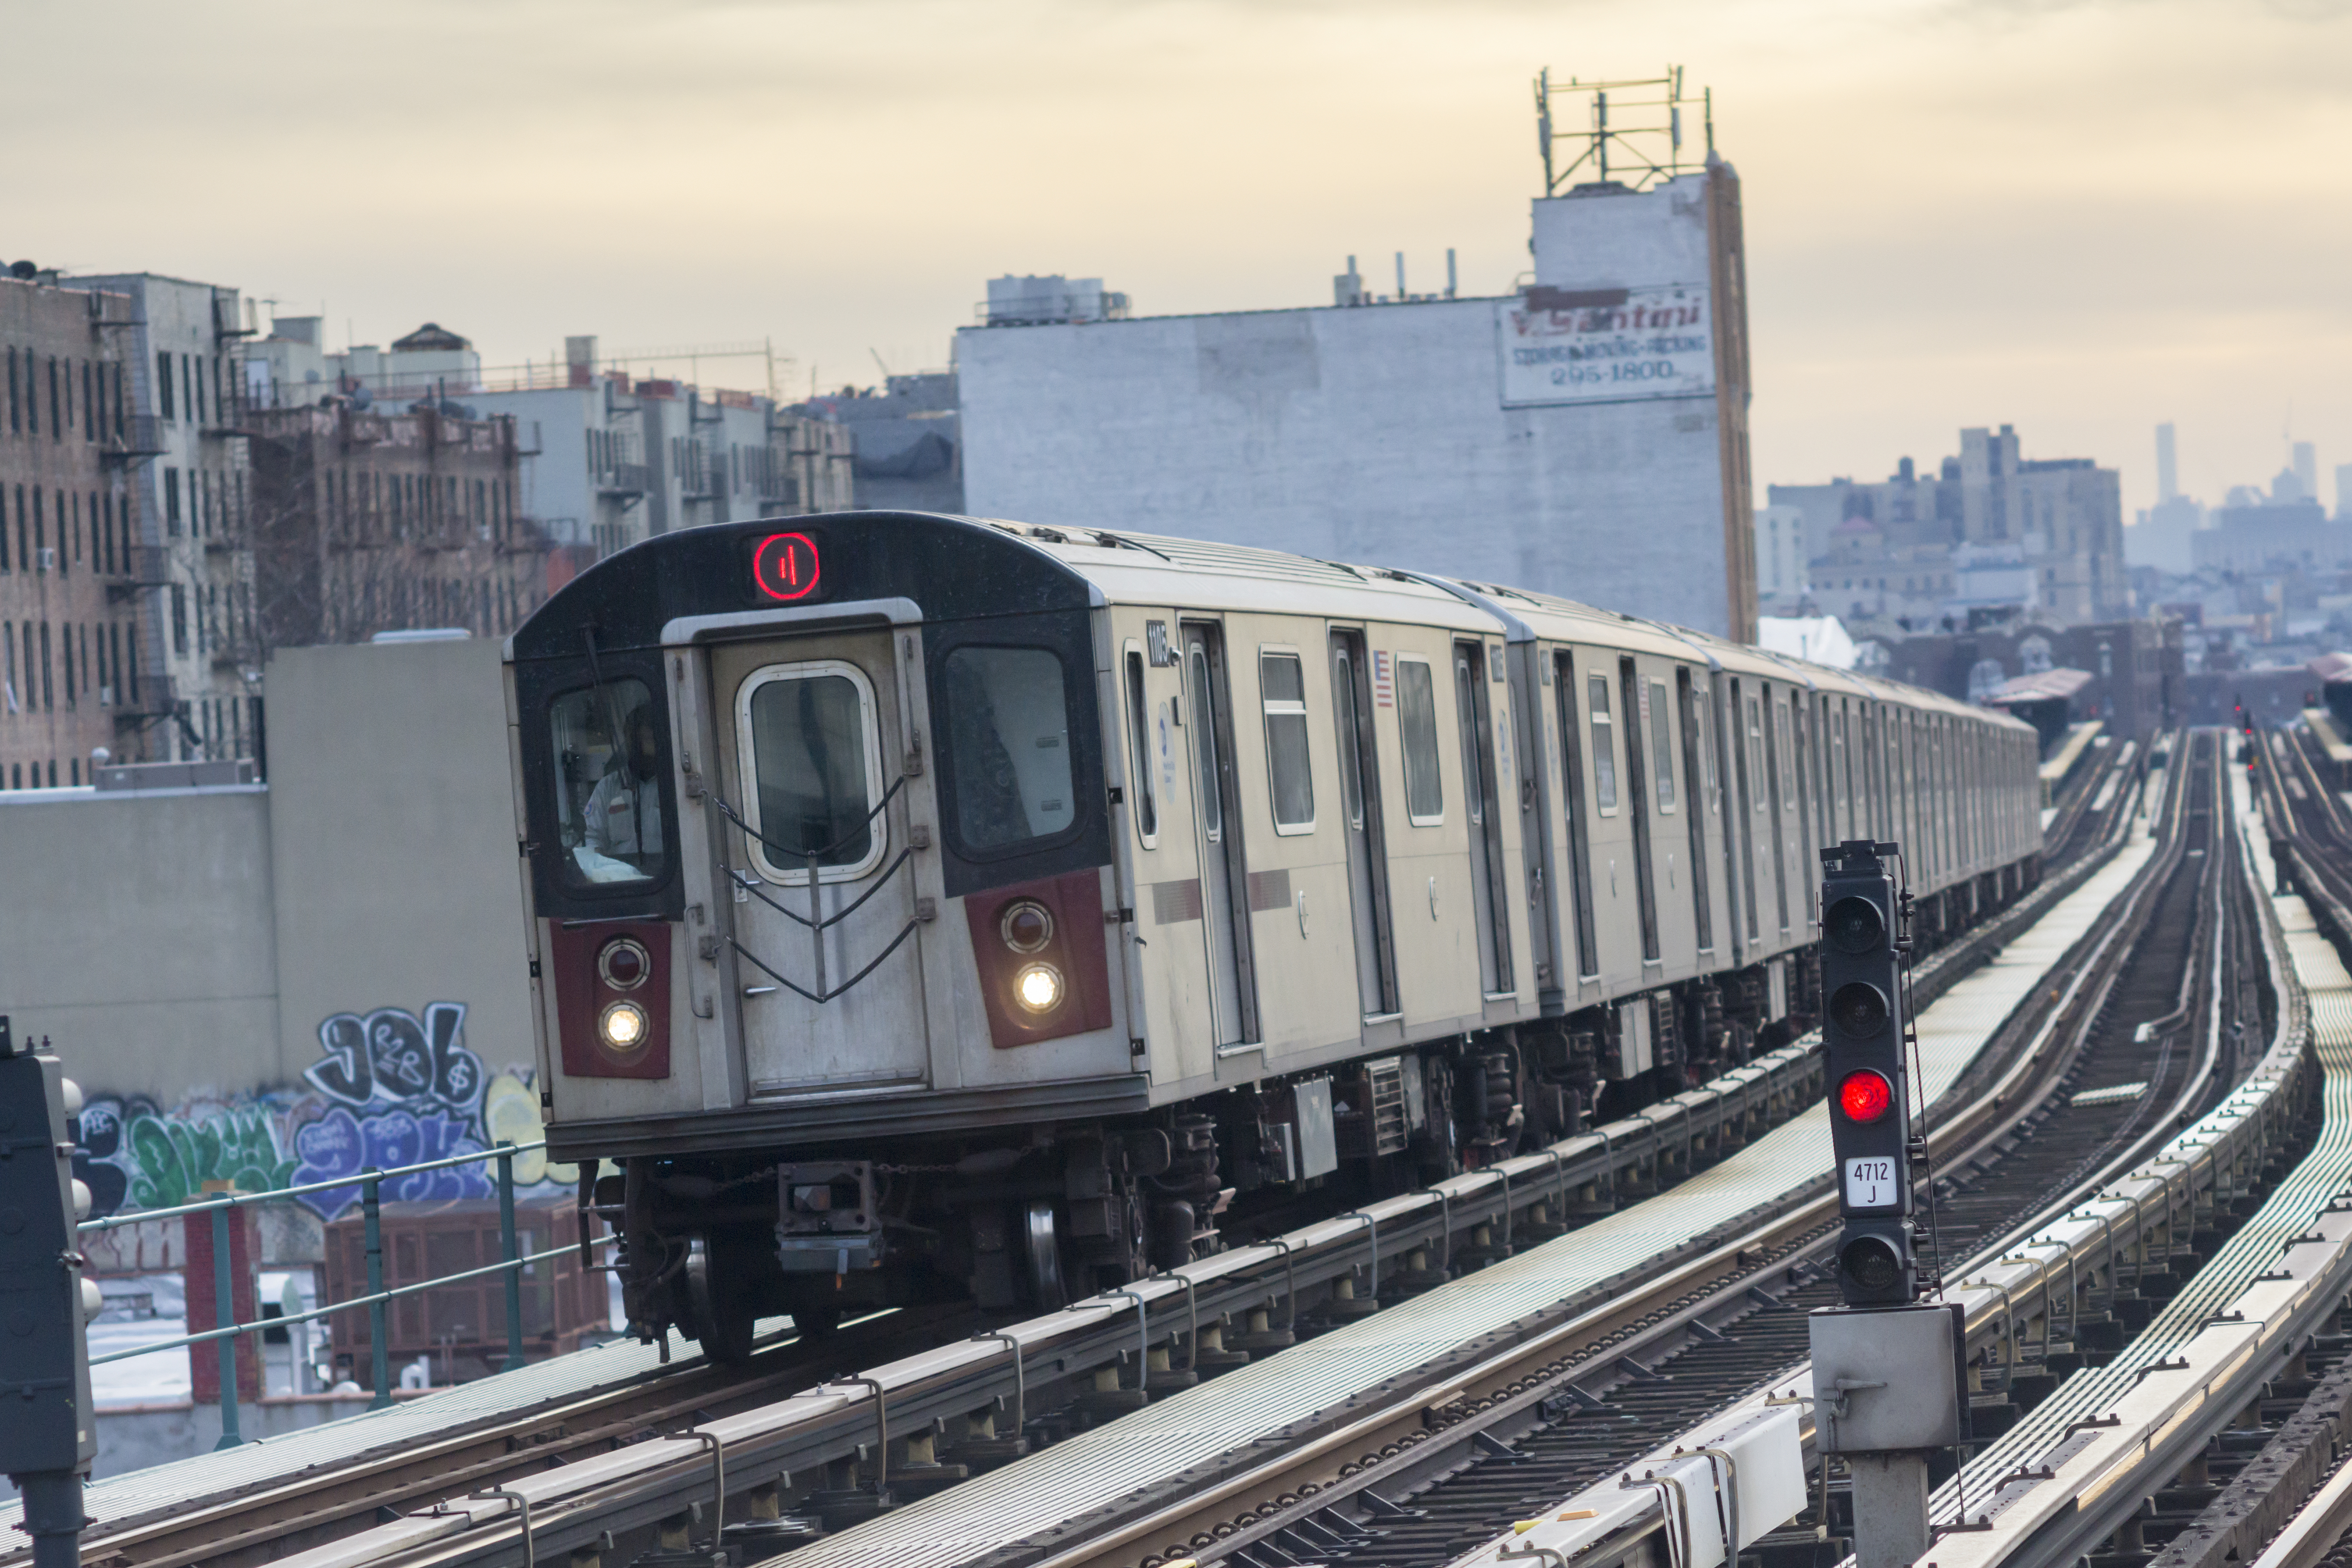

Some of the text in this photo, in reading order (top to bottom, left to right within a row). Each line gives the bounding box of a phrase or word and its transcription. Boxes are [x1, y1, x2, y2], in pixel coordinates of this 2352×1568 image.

[1149, 625, 1168, 662] 1105
[1854, 1162, 1888, 1181] 4712
[1867, 1185, 1876, 1203] J
